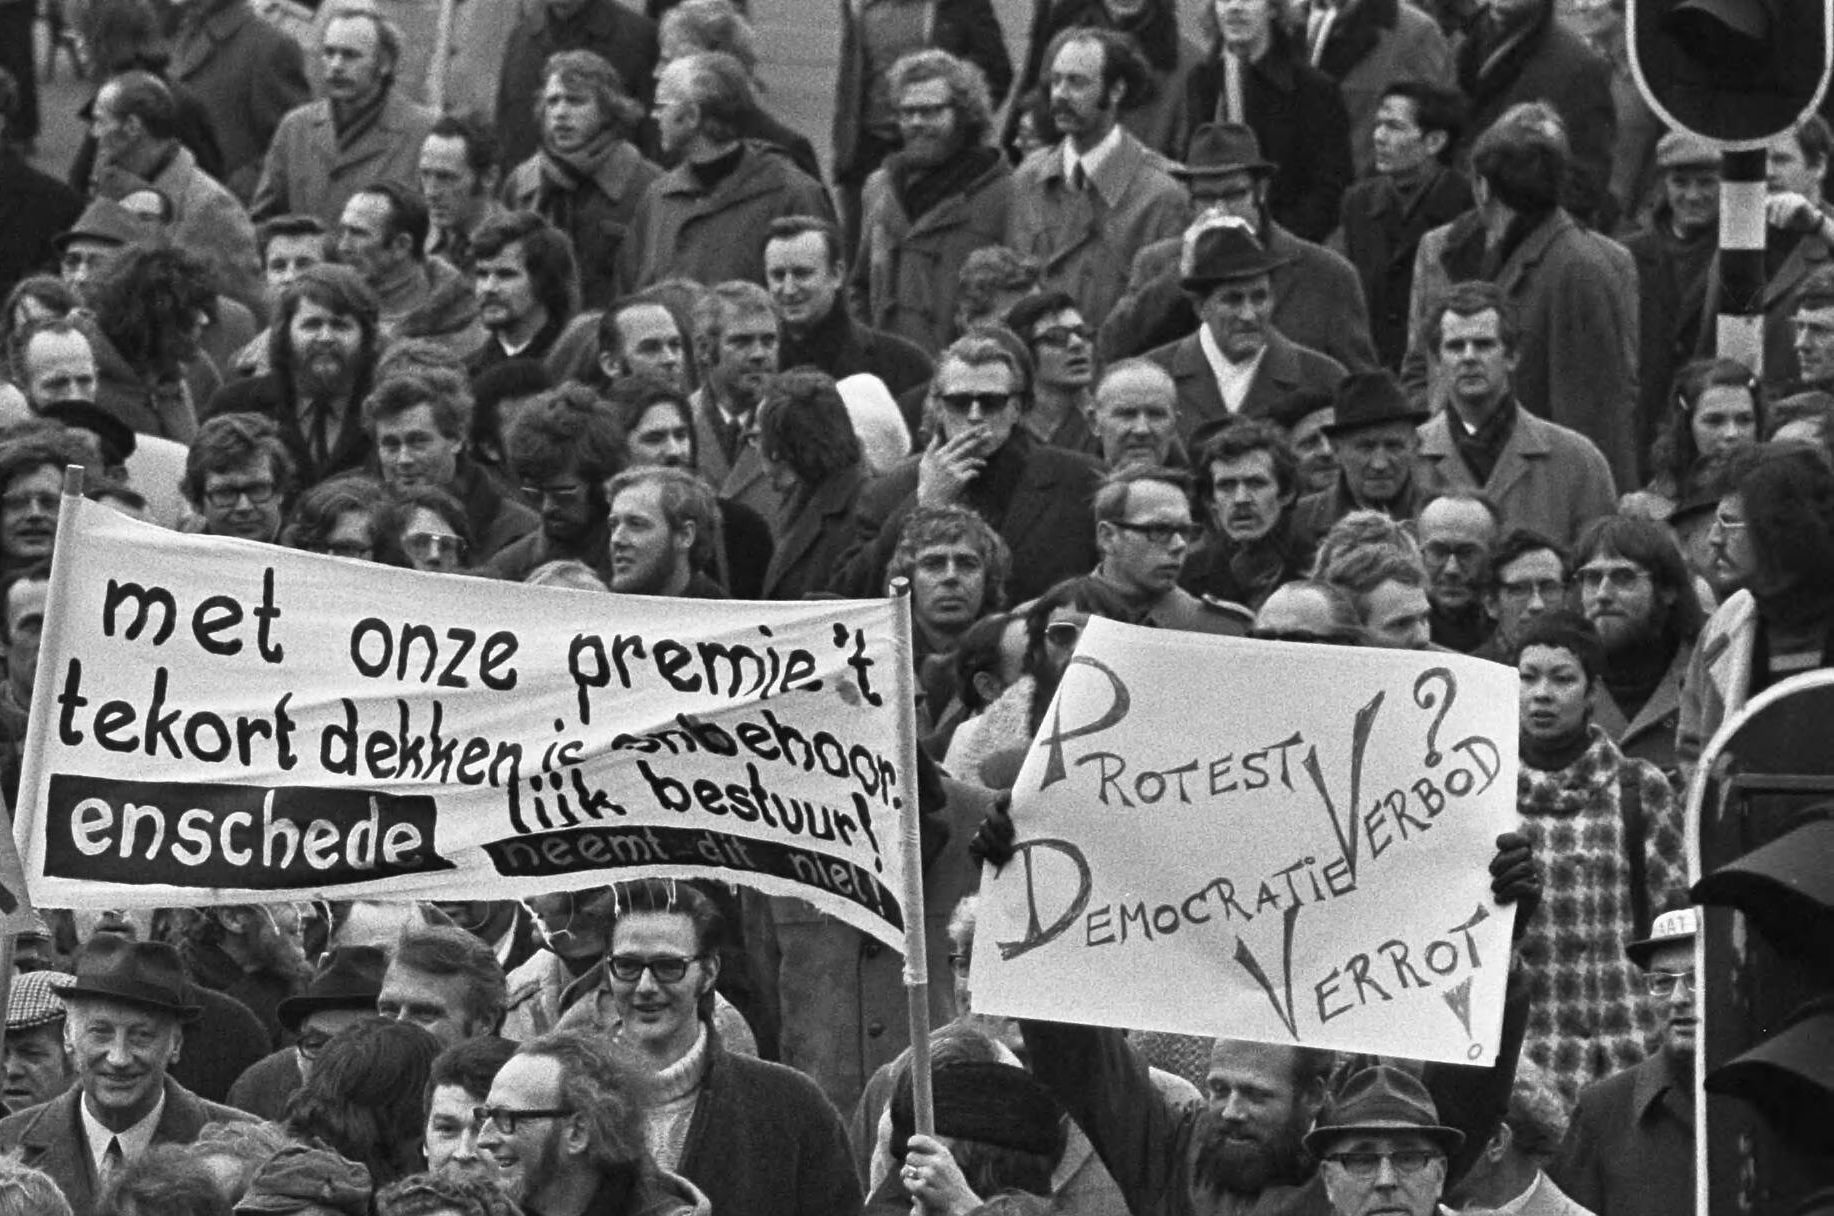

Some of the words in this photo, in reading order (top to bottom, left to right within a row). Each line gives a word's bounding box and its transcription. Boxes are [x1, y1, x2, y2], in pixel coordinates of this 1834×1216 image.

[103, 567, 284, 665] met
[350, 617, 519, 691] onze
[568, 625, 823, 725] premie
[58, 657, 298, 771] tekort
[320, 698, 524, 788] dekken
[1039, 655, 1304, 808] PROTEST
[69, 789, 423, 870] enschede
[502, 826, 669, 868] neemt
[697, 831, 757, 868] dit
[507, 765, 628, 834] lijk
[637, 760, 884, 874] bestuur!
